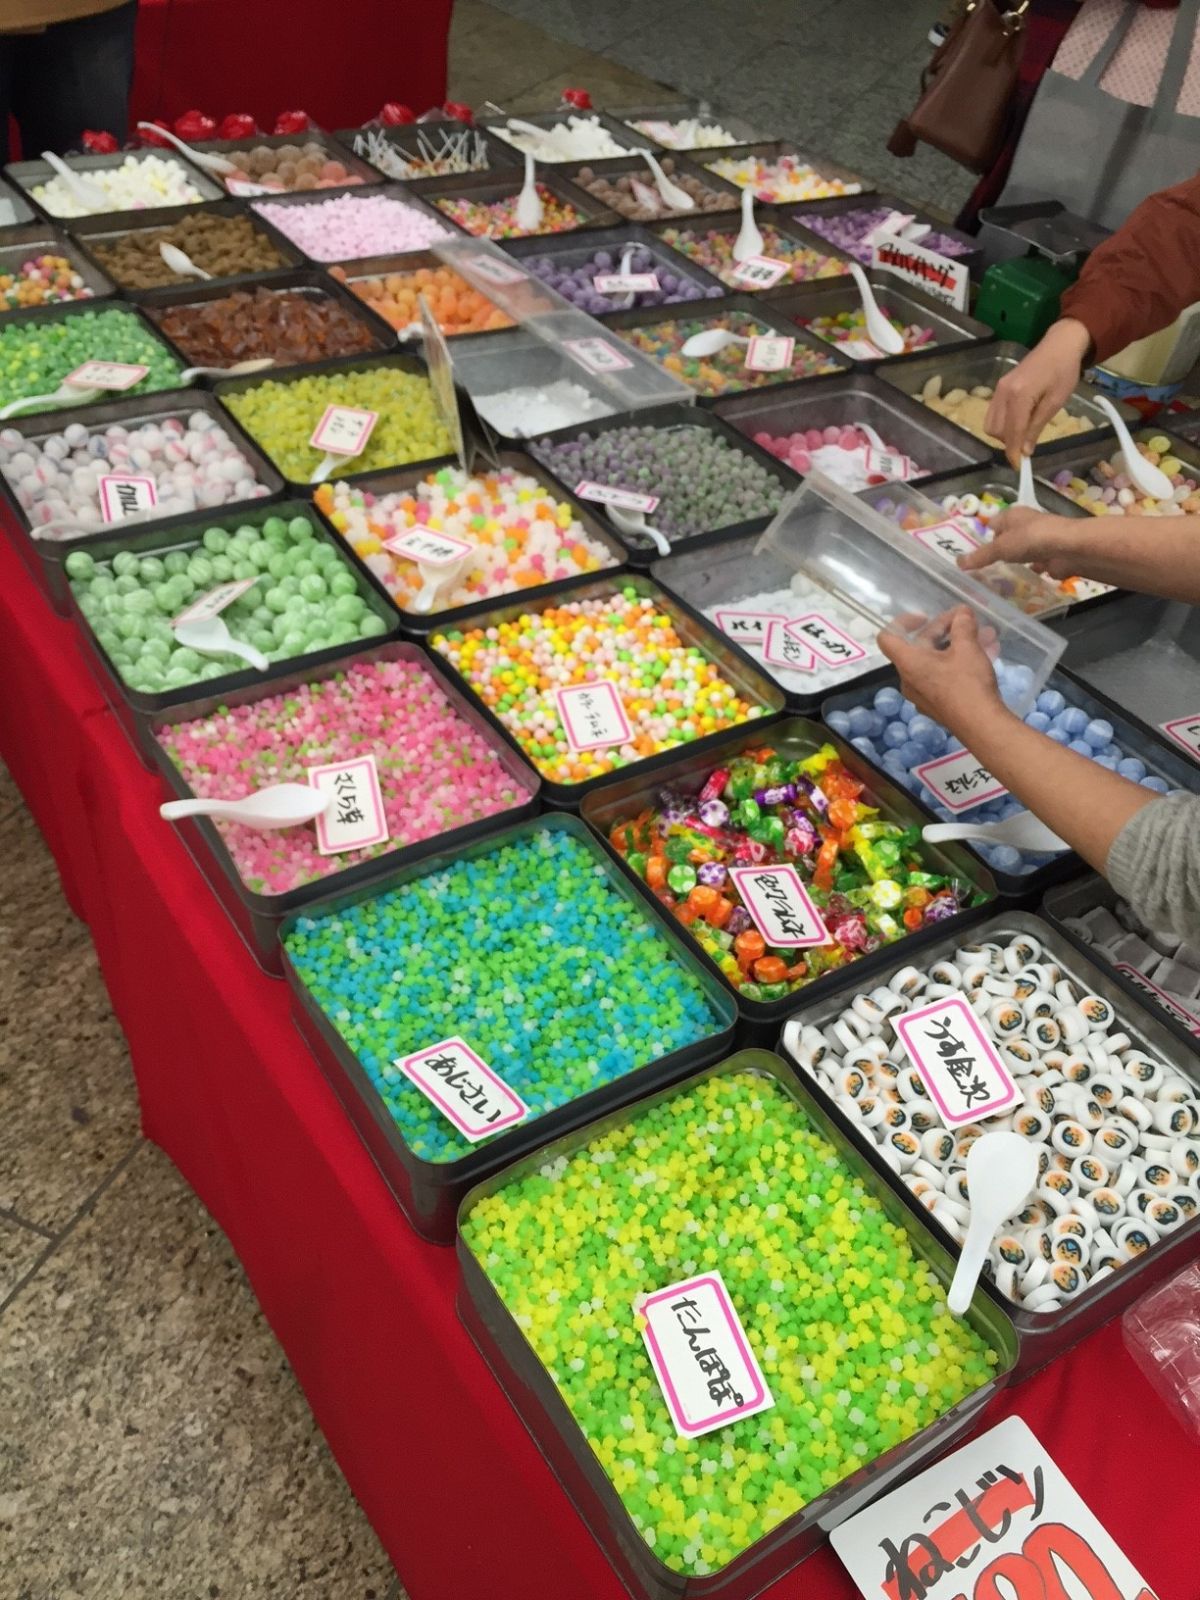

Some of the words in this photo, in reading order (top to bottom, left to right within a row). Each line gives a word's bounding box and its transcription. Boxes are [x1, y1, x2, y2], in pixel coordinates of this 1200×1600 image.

[335, 772, 366, 825] さくら草
[424, 1052, 503, 1124] あじさい
[670, 1296, 745, 1408] たんぽぽ
